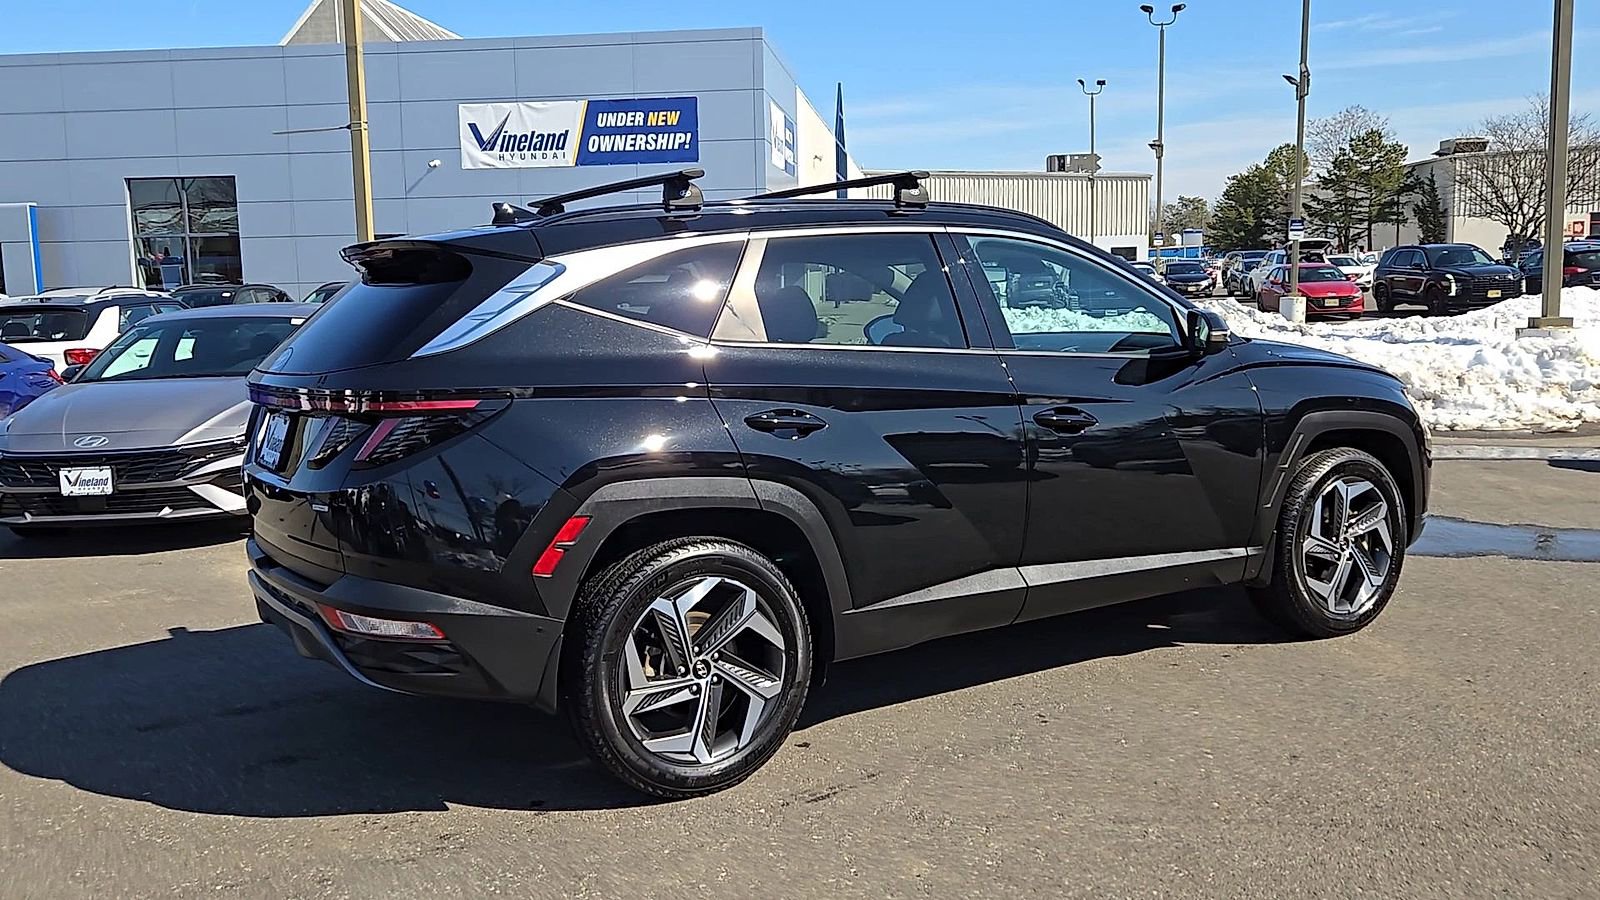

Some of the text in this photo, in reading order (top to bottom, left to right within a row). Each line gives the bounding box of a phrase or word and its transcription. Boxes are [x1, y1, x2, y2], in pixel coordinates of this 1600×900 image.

[597, 110, 680, 128] UNDER NEW
[467, 110, 570, 153] Vineland
[587, 132, 692, 153] OWNERSHIP!
[498, 151, 567, 161] HYUNDAI
[63, 471, 109, 488] Vineland
